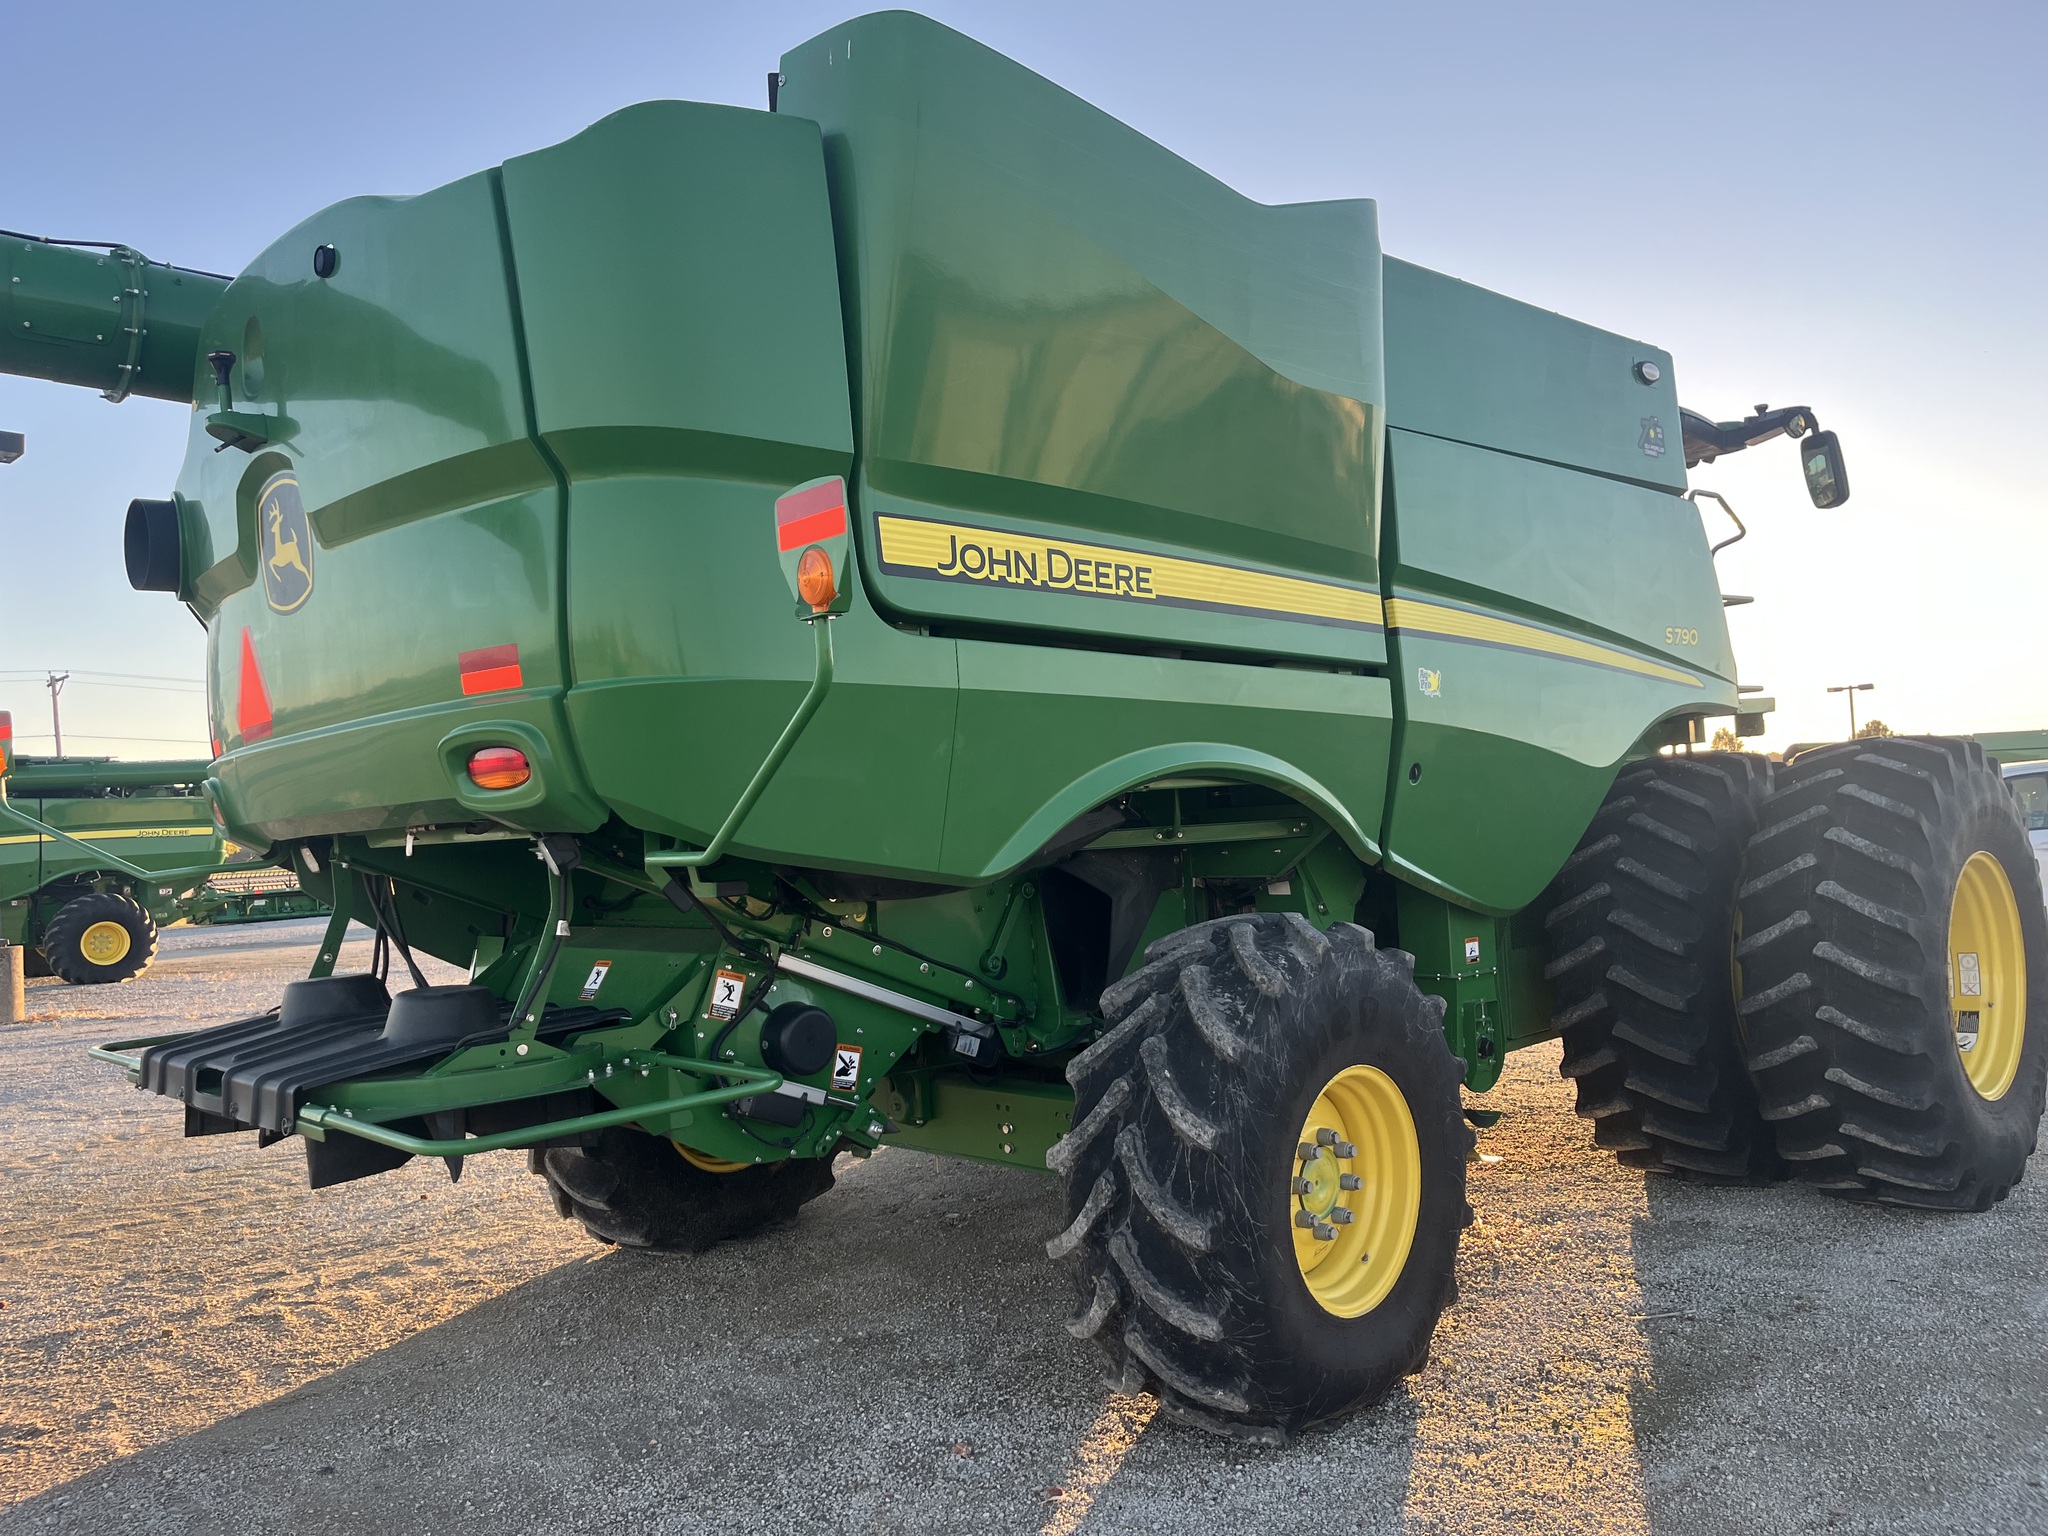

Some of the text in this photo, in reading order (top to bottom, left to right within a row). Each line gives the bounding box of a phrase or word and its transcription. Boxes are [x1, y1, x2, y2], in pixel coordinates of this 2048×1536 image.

[937, 534, 1154, 596] JOHN DEERE
[1665, 627, 1699, 646] S790
